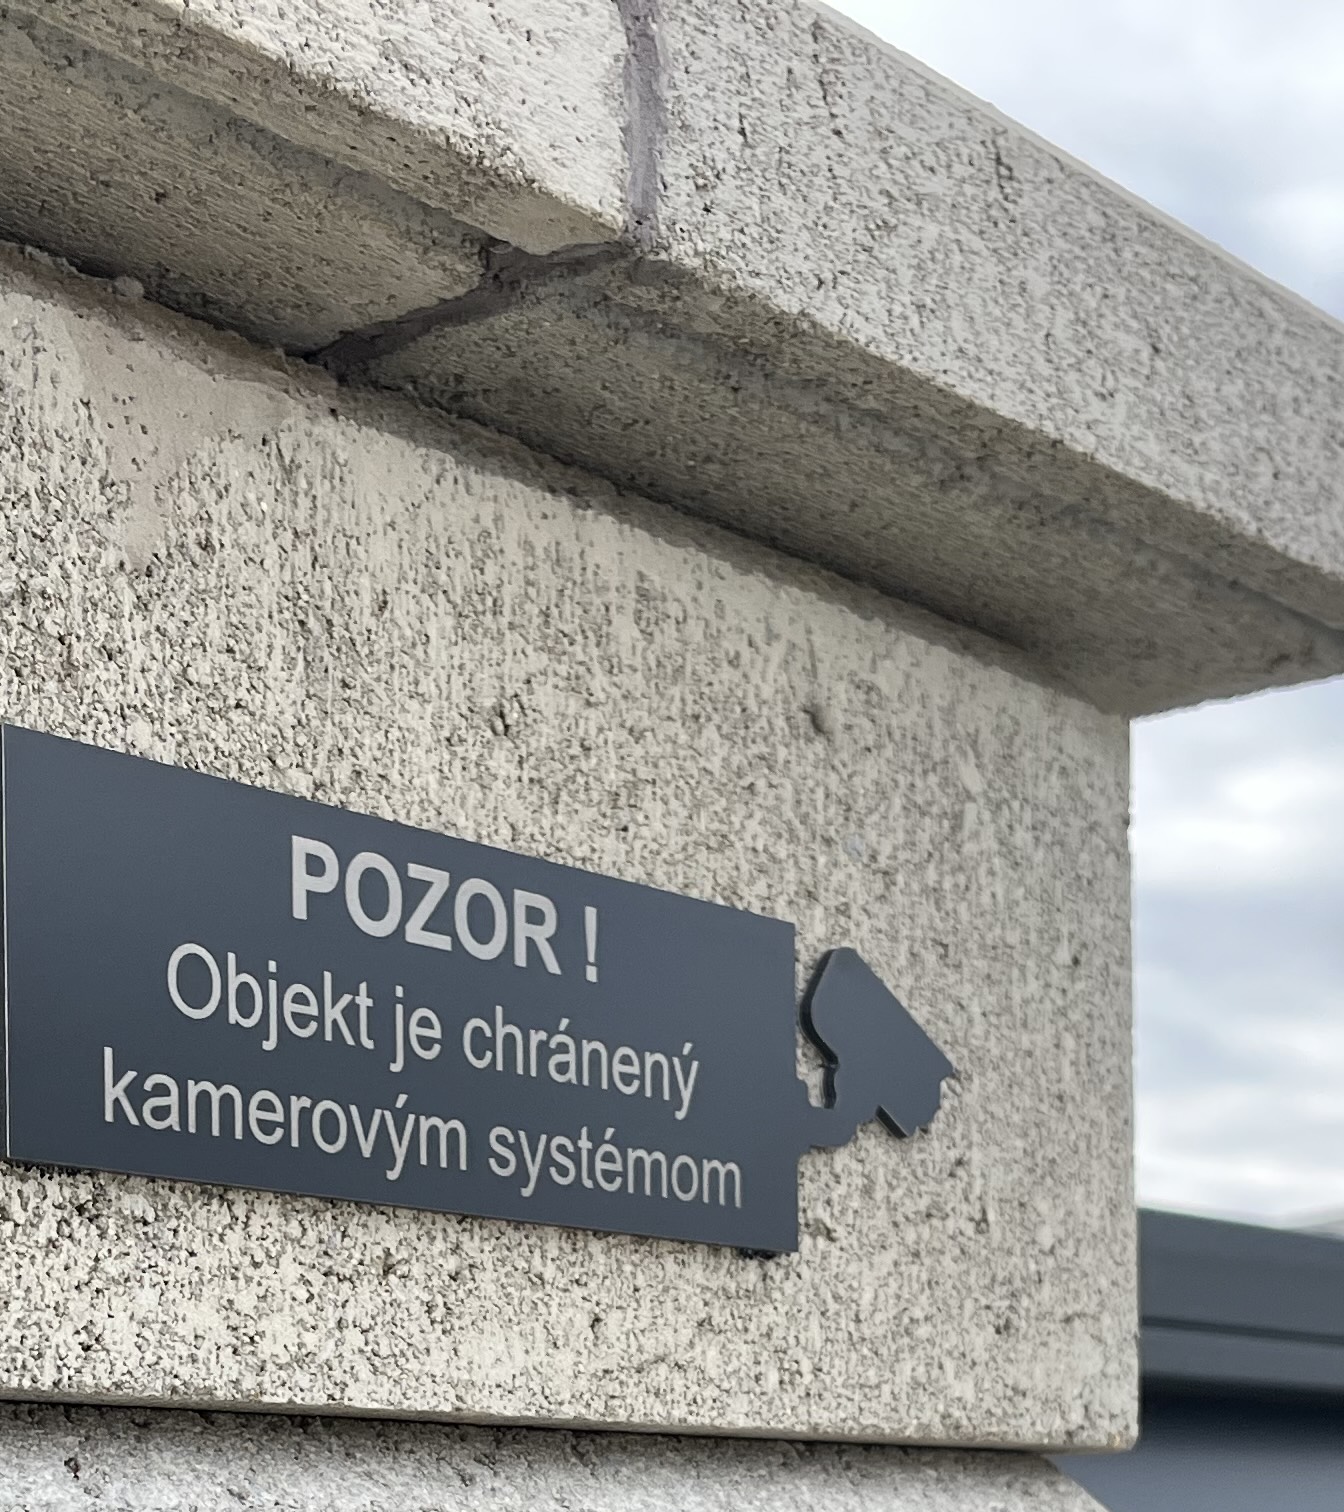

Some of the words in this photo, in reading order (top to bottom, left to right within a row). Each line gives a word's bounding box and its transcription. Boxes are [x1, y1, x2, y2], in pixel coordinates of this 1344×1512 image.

[291, 834, 564, 976] POZOR
[583, 905, 599, 983] !
[166, 942, 375, 1051] Objekt
[389, 984, 443, 1073] je
[462, 1004, 700, 1121] chránený
[103, 1046, 468, 1181] kamerovým
[488, 1125, 742, 1209] systémom
